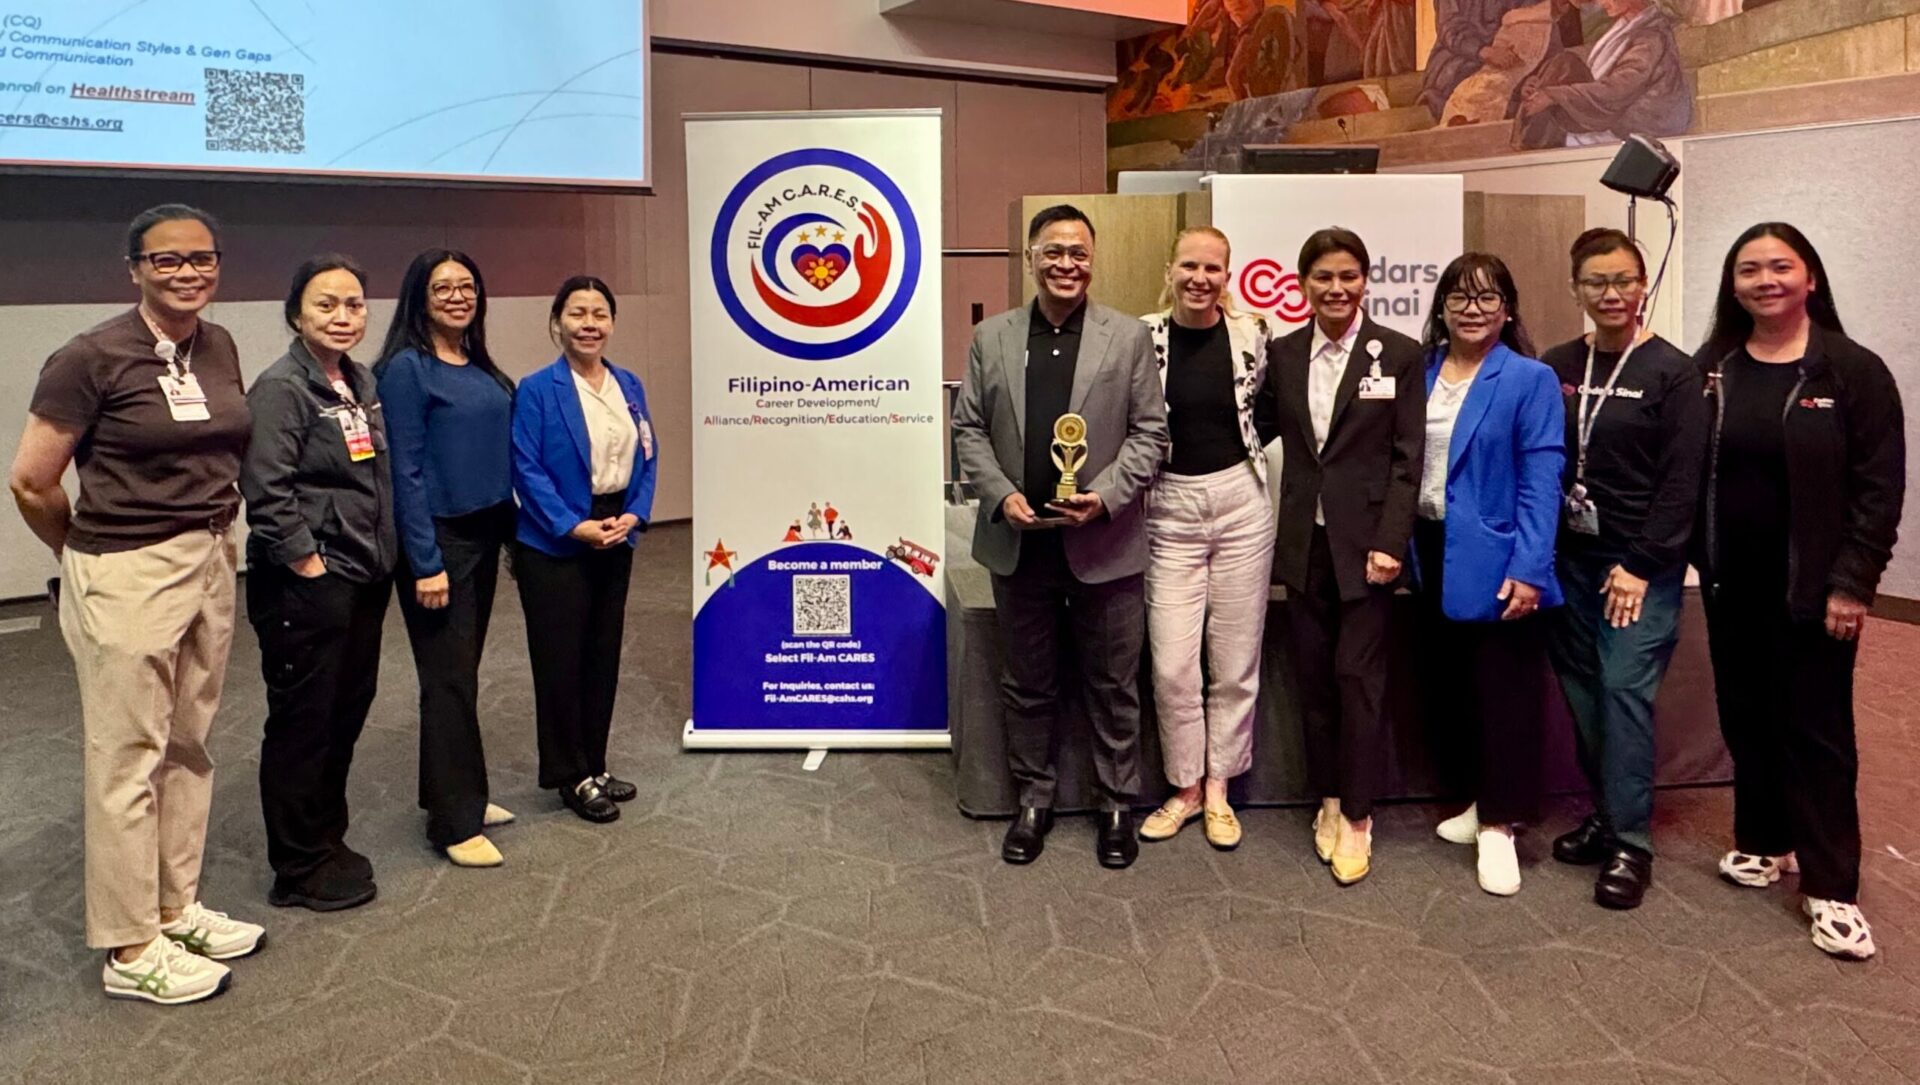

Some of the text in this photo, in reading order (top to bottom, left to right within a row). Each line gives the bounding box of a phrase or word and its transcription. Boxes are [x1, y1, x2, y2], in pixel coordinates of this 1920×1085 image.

[3, 14, 42, 30] (CQ)
[9, 30, 131, 51] Communication
[136, 40, 181, 56] Styles
[186, 44, 196, 56] &
[201, 46, 231, 58] Gen
[235, 48, 272, 63] Gaps
[11, 46, 134, 66] Communication
[45, 85, 65, 95] on
[70, 82, 195, 105] Healthstream
[747, 184, 858, 249] FIL-AM C.A.R.E.S.
[1368, 256, 1439, 284] dars
[1363, 289, 1420, 316] inai
[728, 375, 910, 396] Filipino-American
[1615, 387, 1644, 399] Sinai
[756, 399, 794, 409] Career
[704, 413, 934, 427] Alliance/Recognition/Education/Service
[768, 559, 883, 571] Become a member
[781, 640, 861, 650] (scan the QR code)
[765, 653, 876, 663] Select Fil-Am CARES
[762, 682, 778, 690] For
[823, 682, 860, 690] contact
[764, 694, 874, 704] Fil-AmCARES@cshs.org
